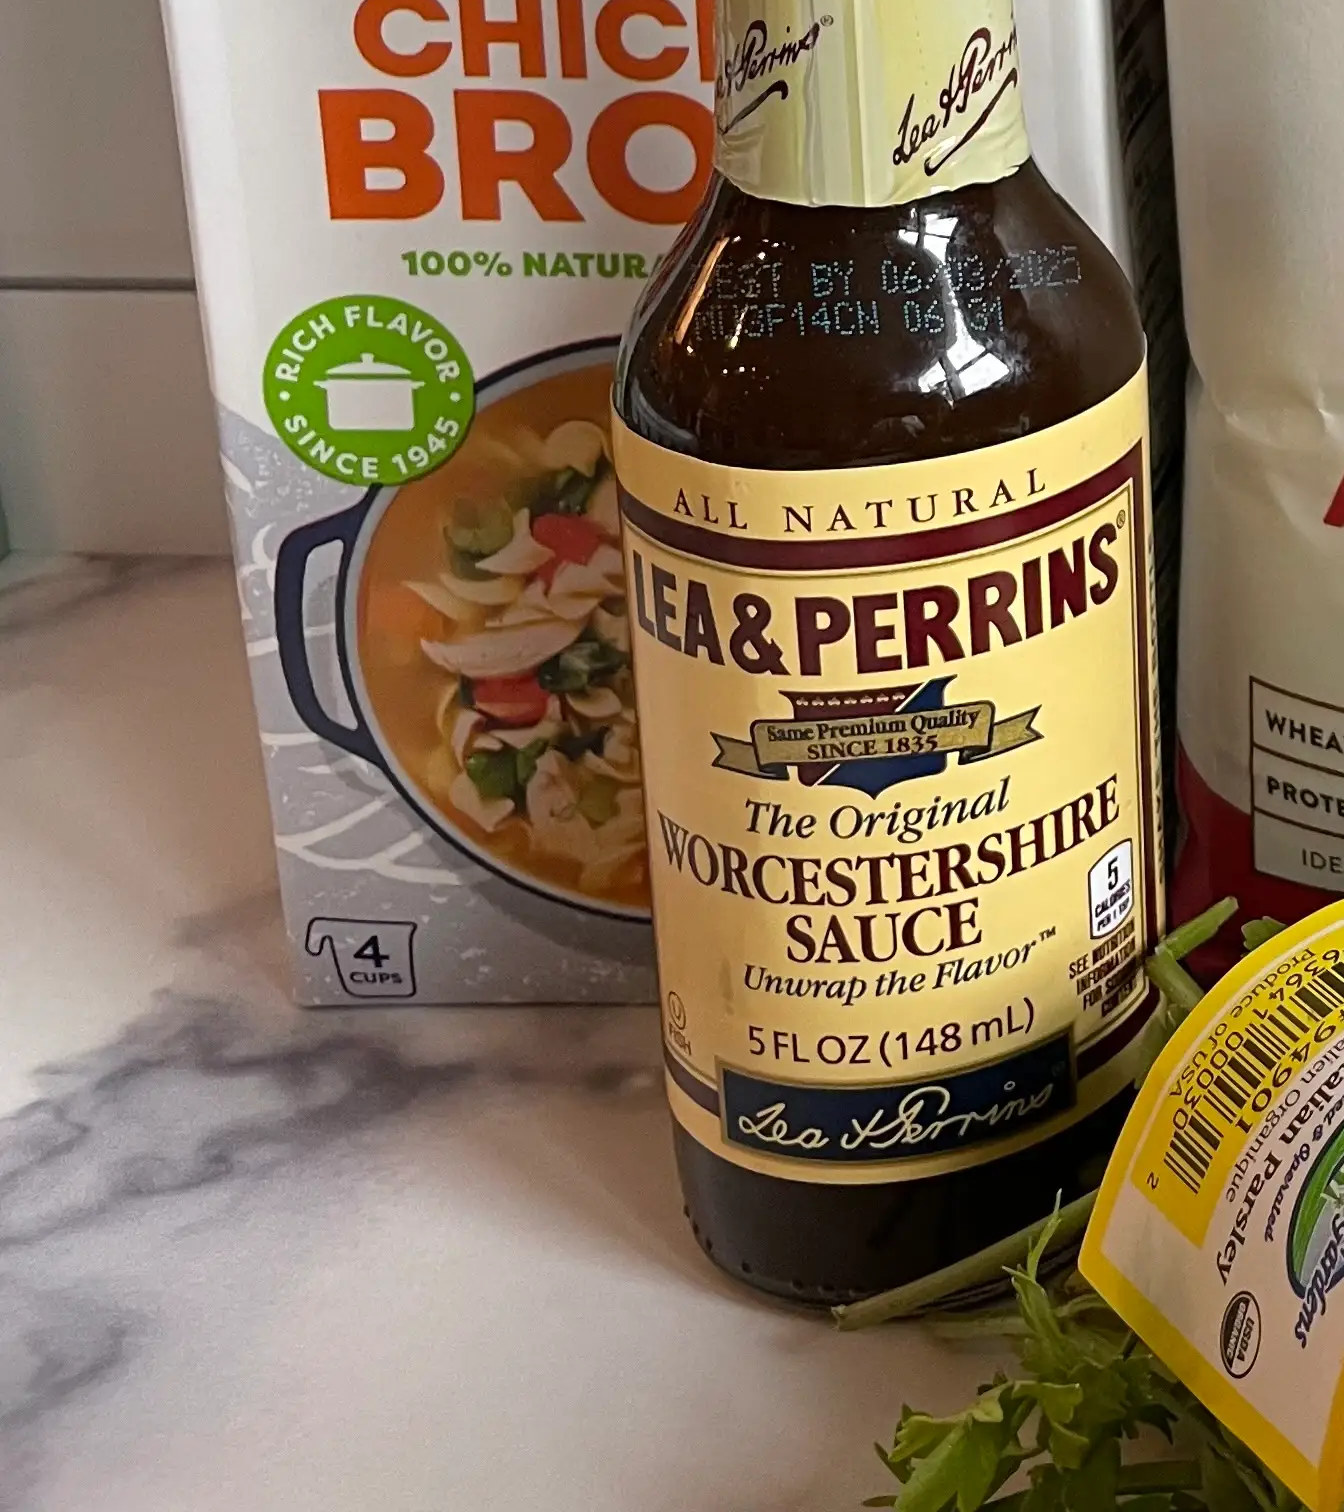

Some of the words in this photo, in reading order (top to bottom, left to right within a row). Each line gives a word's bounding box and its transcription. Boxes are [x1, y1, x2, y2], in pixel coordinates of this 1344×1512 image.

[318, 89, 716, 225] BRO
[401, 251, 512, 278] 100%
[811, 259, 855, 297] BY
[275, 312, 336, 384] RICH
[343, 304, 462, 385] FLAVOR
[283, 414, 379, 479] SINCE
[392, 416, 461, 476] 1945
[672, 488, 749, 531] ALL
[783, 467, 1046, 533] NATURAL
[767, 725, 814, 742] Same
[816, 718, 908, 738] Premium
[910, 706, 982, 735] Quality
[807, 739, 876, 760] SINCE
[881, 734, 938, 755] 1835
[657, 774, 1120, 908] WORCESTERSHIRE
[744, 798, 816, 840] The
[829, 775, 1011, 844] Original
[1107, 856, 1118, 891] 5
[353, 934, 389, 968] 4
[786, 897, 983, 964] SAUCE
[350, 971, 402, 985] CUPS
[743, 963, 868, 1007] Unwrap
[874, 963, 925, 998] the
[1230, 947, 1318, 1019] Produce
[1252, 949, 1341, 1021] 63641
[748, 1025, 765, 1056] 5
[773, 1031, 810, 1064] FL
[817, 1035, 871, 1065] OZ
[879, 1022, 962, 1068] (148
[972, 997, 1036, 1044] mL)
[1208, 1021, 1228, 1049] of
[1169, 1051, 1209, 1097] USA
[1172, 1031, 1244, 1131] 00030
[1225, 1088, 1301, 1203] Organique
[1216, 1149, 1283, 1285] Parsley
[1264, 1142, 1311, 1243] Operated
